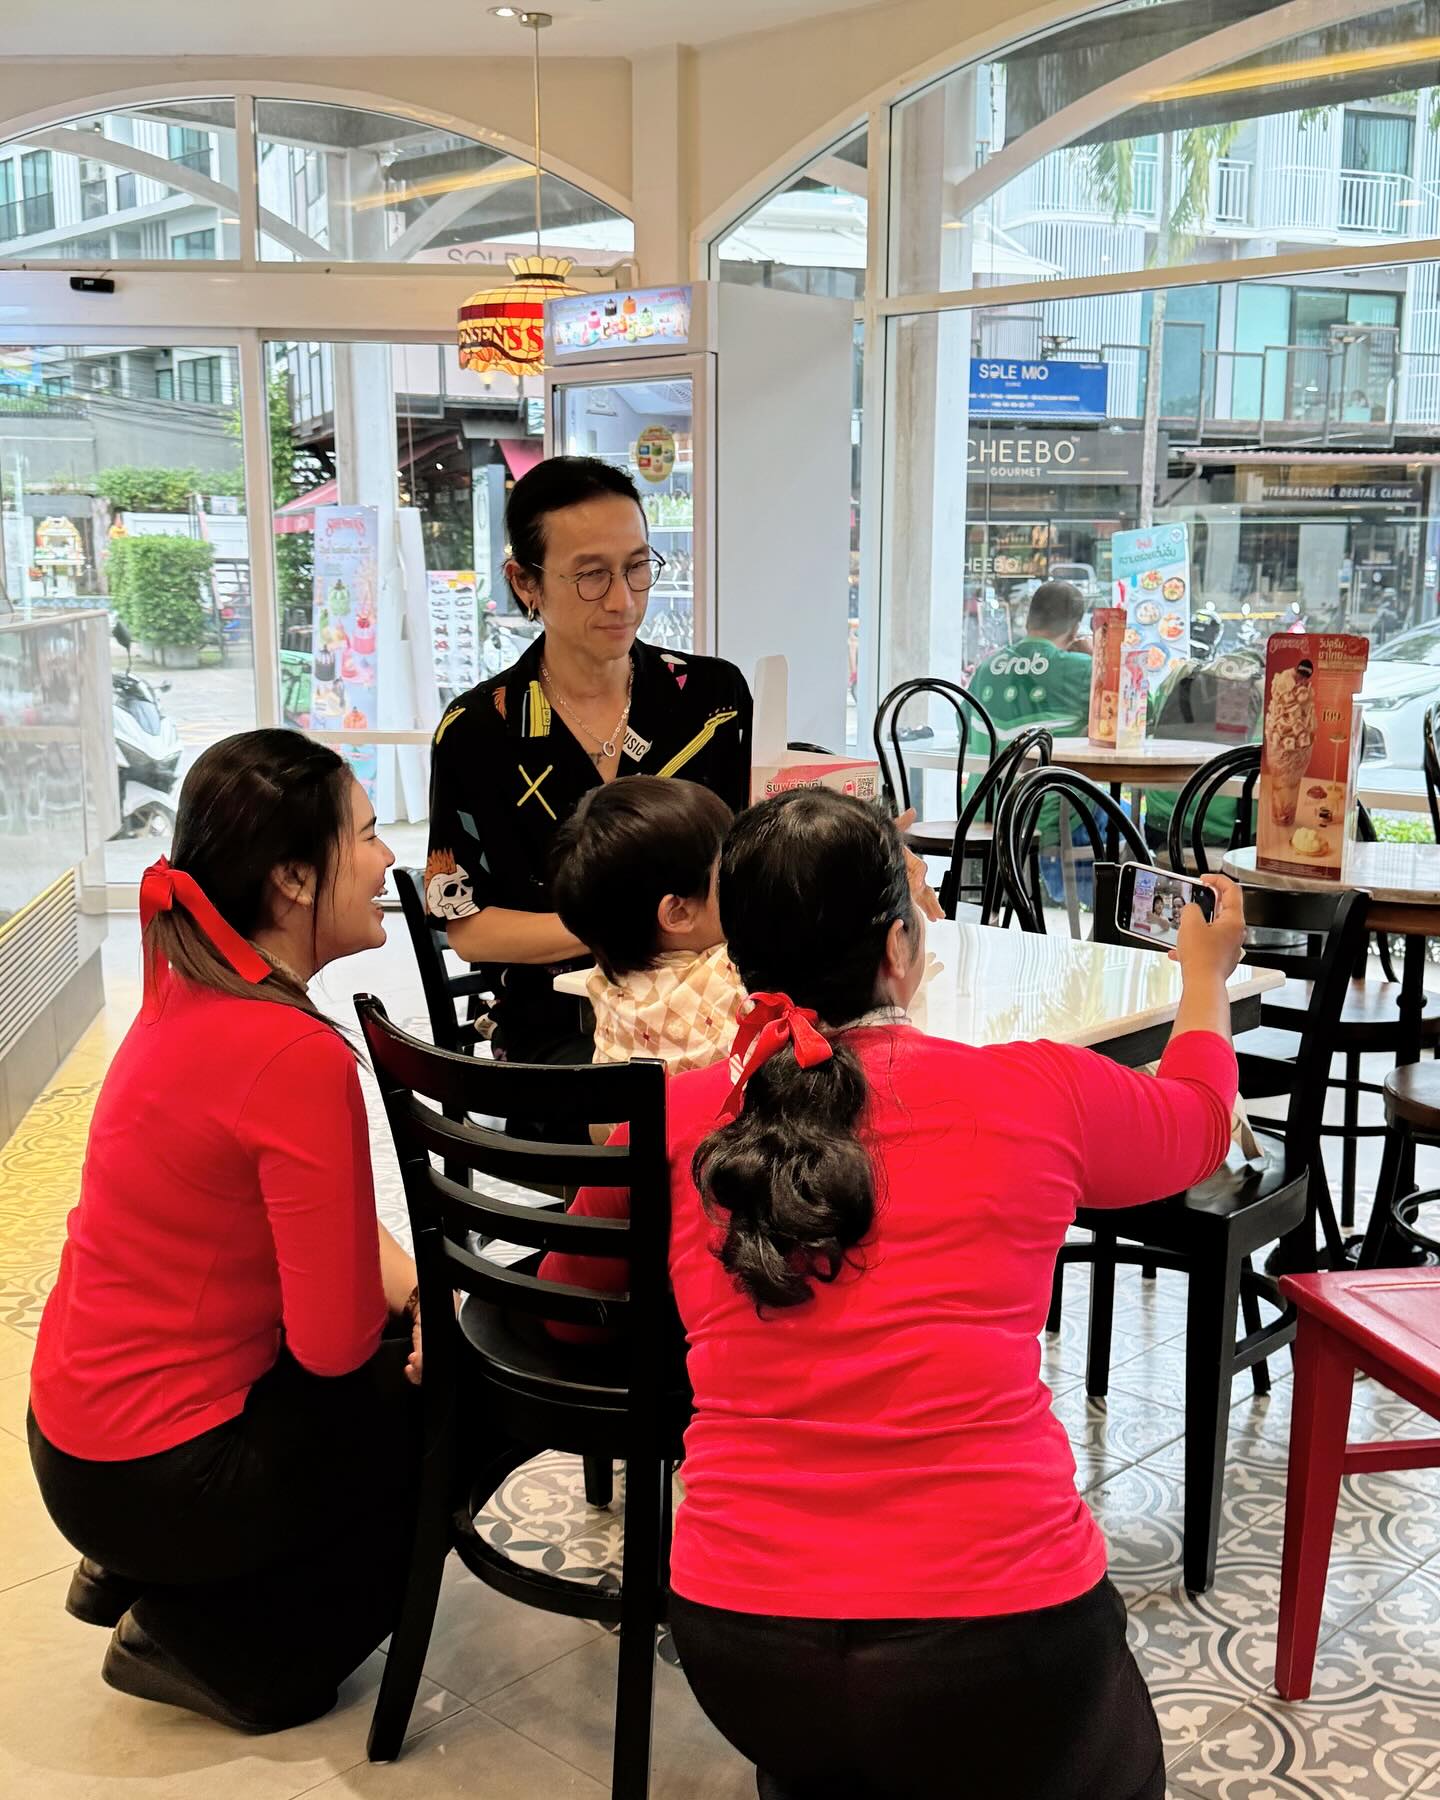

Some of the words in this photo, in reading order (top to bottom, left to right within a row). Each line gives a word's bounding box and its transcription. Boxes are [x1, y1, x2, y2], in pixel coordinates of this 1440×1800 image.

[979, 363, 1018, 379] SOLE
[1021, 365, 1049, 380] MIO
[990, 467, 1041, 477] GOURMET
[1339, 487, 1376, 499] DENTAL
[1380, 488, 1413, 499] CLINIC
[990, 652, 1049, 675] Grab
